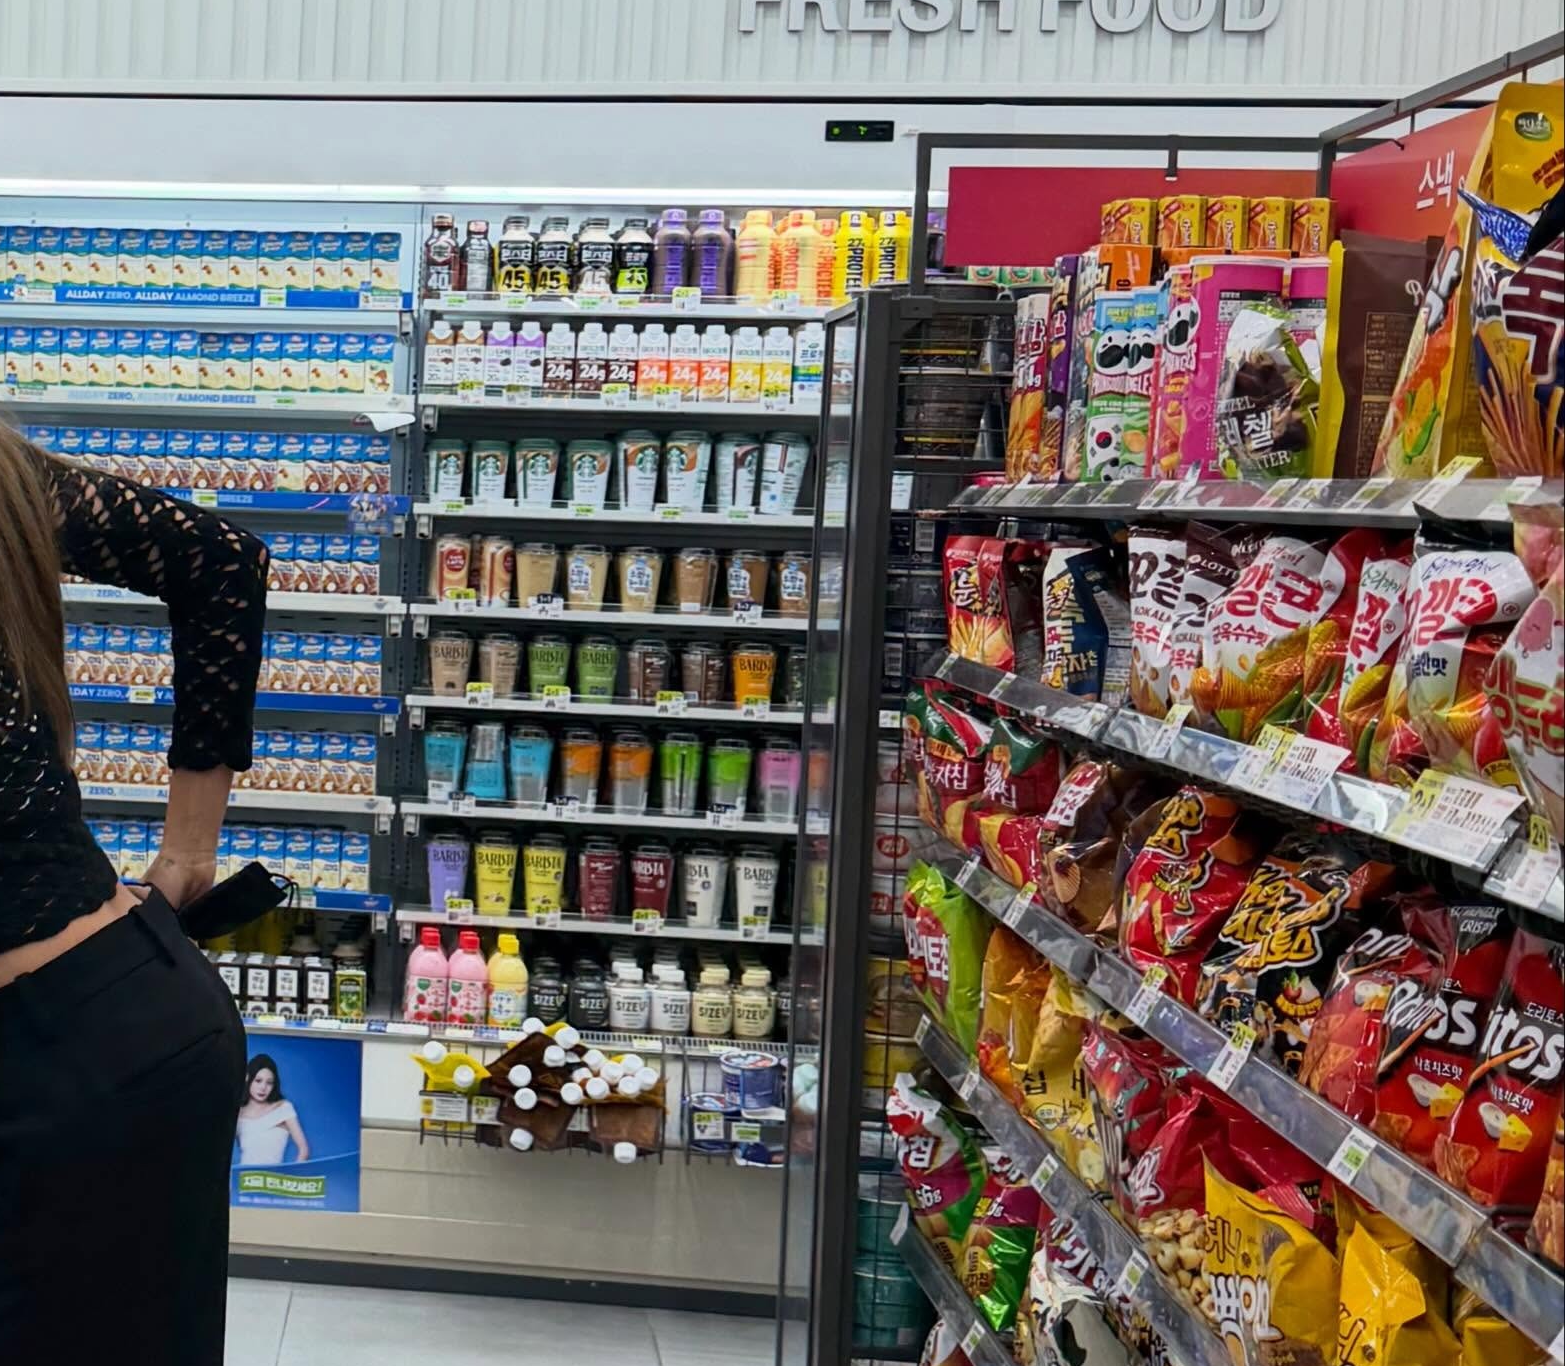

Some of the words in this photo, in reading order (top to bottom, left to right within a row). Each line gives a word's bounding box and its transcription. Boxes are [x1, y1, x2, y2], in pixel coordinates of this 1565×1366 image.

[1415, 149, 1455, 210] 스낵
[502, 269, 526, 286] 45
[65, 289, 105, 300] ALLDAY
[135, 291, 174, 302] ALLDAY
[175, 292, 219, 303] ALMOND
[220, 292, 256, 303] BREEZE
[547, 363, 574, 381] 24g
[579, 364, 606, 383] 24g
[609, 364, 637, 383] 24g
[176, 392, 220, 404] ALMOND
[221, 393, 257, 404] BREEZE
[432, 848, 468, 864] BARIST
[685, 864, 710, 879] ISTA
